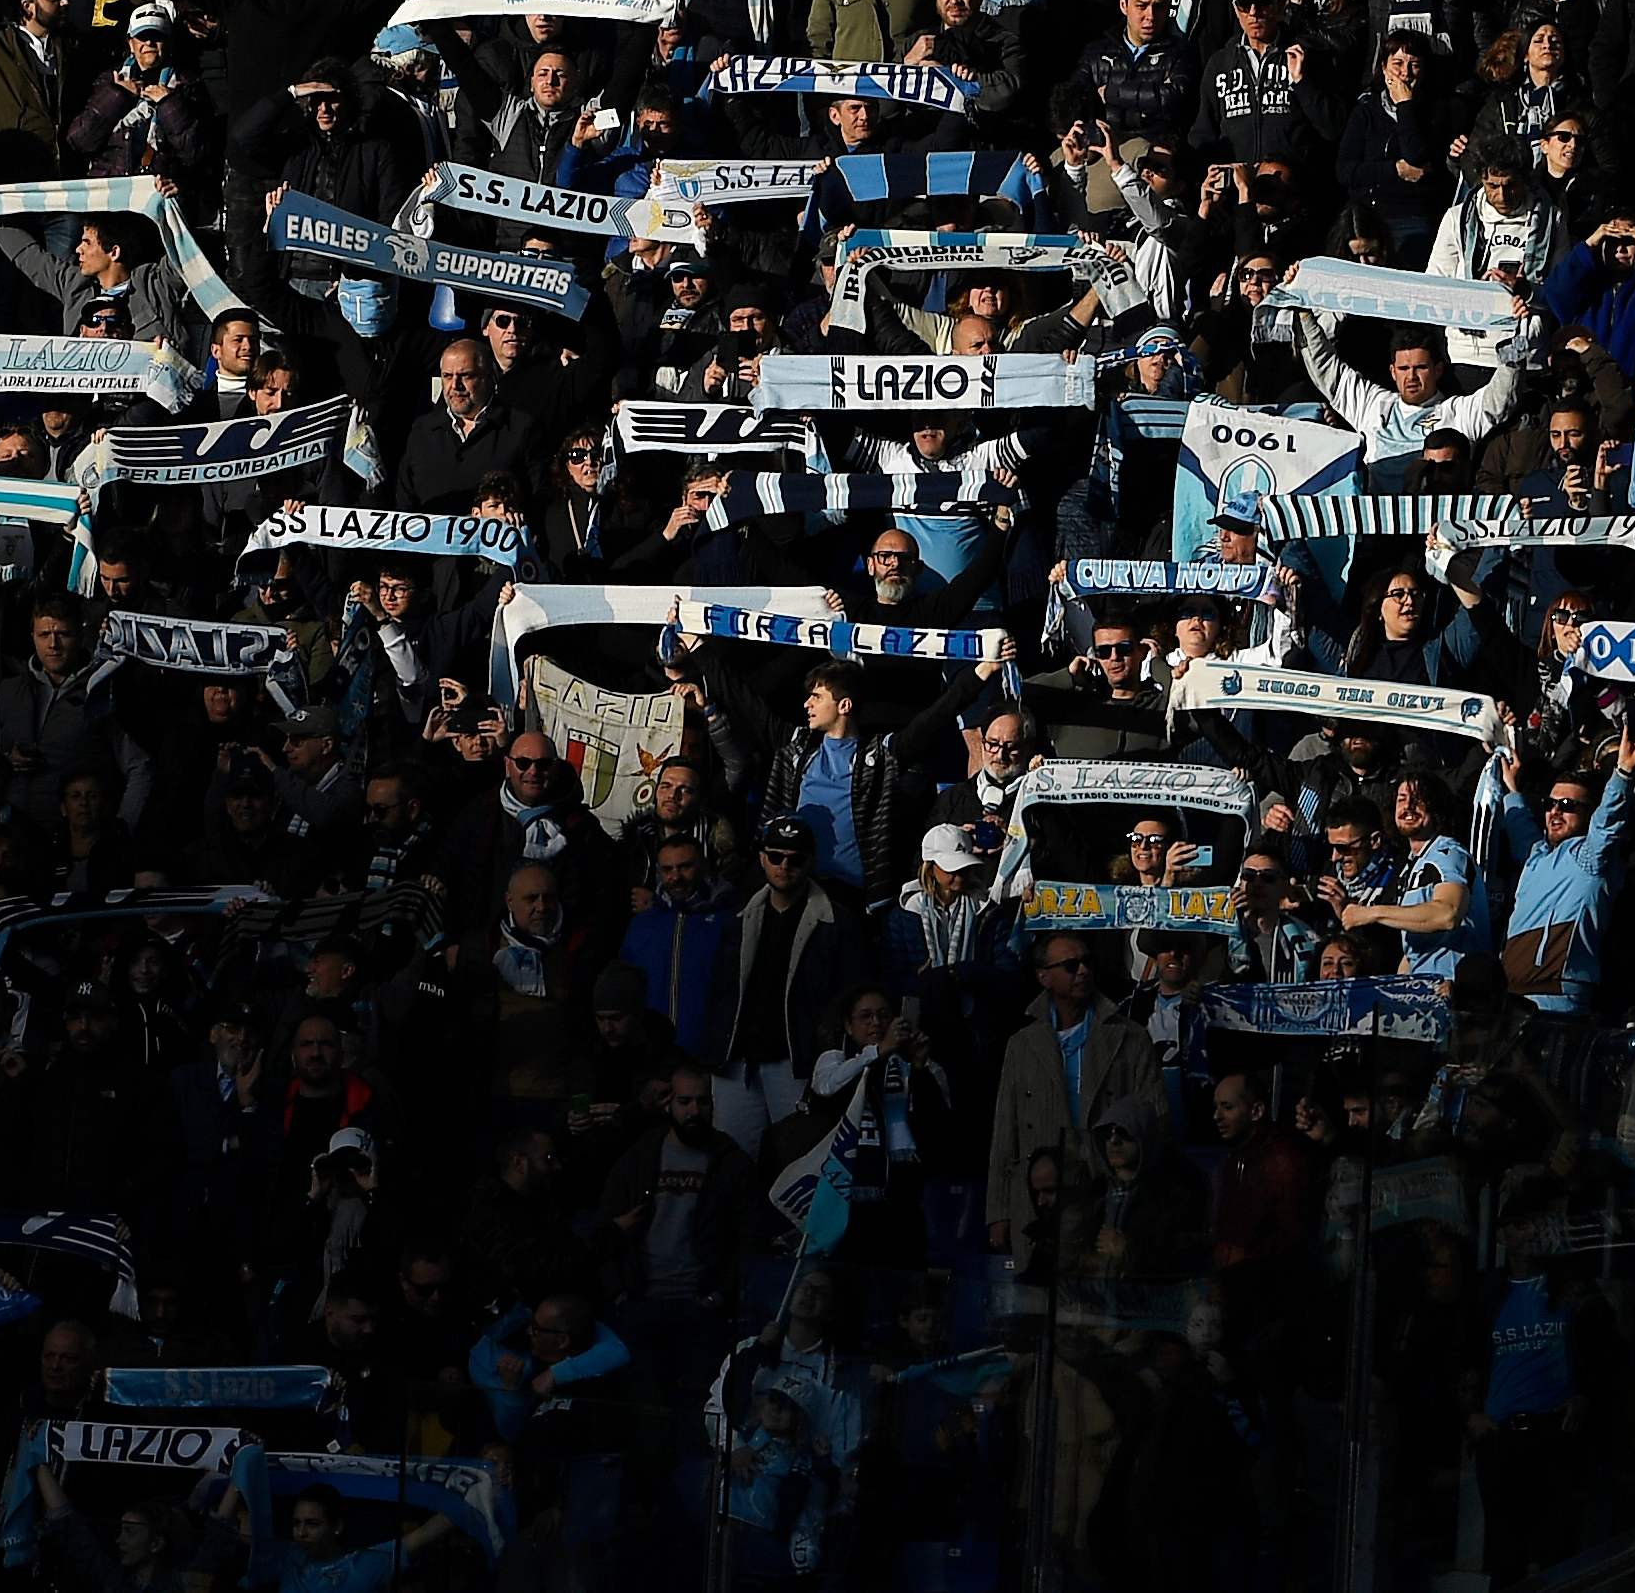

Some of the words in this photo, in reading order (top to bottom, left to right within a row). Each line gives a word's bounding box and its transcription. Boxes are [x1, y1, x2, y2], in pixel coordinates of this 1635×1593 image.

[714, 56, 813, 94] LAZIO
[864, 62, 964, 110] 1900
[713, 166, 760, 191] S.S.
[459, 172, 510, 207] S.S.
[521, 185, 609, 224] LAZIO
[286, 216, 379, 252] EAGLES'
[435, 251, 572, 296] SUPPORTERS
[906, 252, 985, 264] ORIGINAL
[4, 337, 133, 373] LAZIO
[34, 374, 73, 389] DELLA
[74, 375, 140, 391] CAPITALE
[856, 363, 969, 402] LAZIO
[1211, 423, 1298, 454] 1900
[116, 466, 160, 483] PER
[165, 466, 198, 483] LEI
[268, 507, 308, 538] SS
[320, 508, 431, 542] LAZIO
[445, 514, 521, 553] 1900
[1077, 559, 1165, 590] CURVA
[1173, 559, 1261, 594] NORD
[704, 606, 828, 646] FORZA
[854, 622, 985, 659] LAZIO
[535, 662, 674, 726] LAZIO
[1257, 679, 1322, 698] CUORE
[1336, 686, 1374, 703] NEL
[1389, 691, 1446, 711] LAZIO
[1068, 765, 1190, 792] LAZIO
[1070, 792, 1111, 801] STADIO
[1112, 792, 1163, 801] OLIMPICO
[80, 1424, 213, 1468] LAZIO
